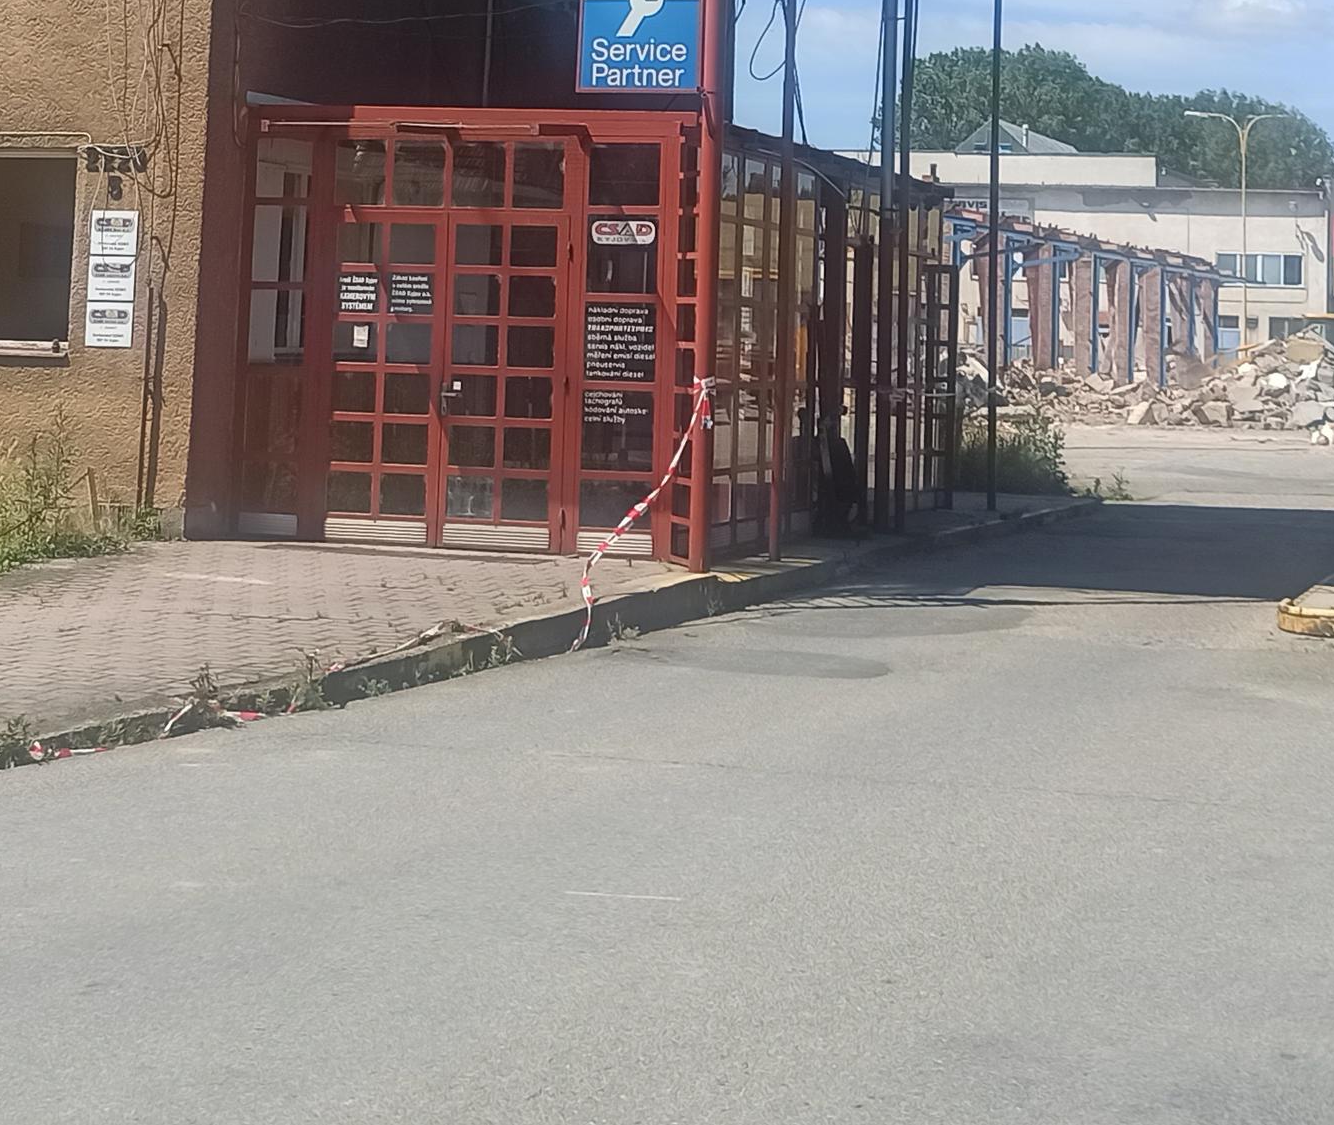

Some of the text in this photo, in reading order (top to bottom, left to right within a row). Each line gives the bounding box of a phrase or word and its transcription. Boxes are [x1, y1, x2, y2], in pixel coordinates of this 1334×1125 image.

[591, 37, 688, 62] Service
[591, 63, 685, 87] Partner
[619, 307, 649, 315] doprava
[613, 316, 643, 324] doprava
